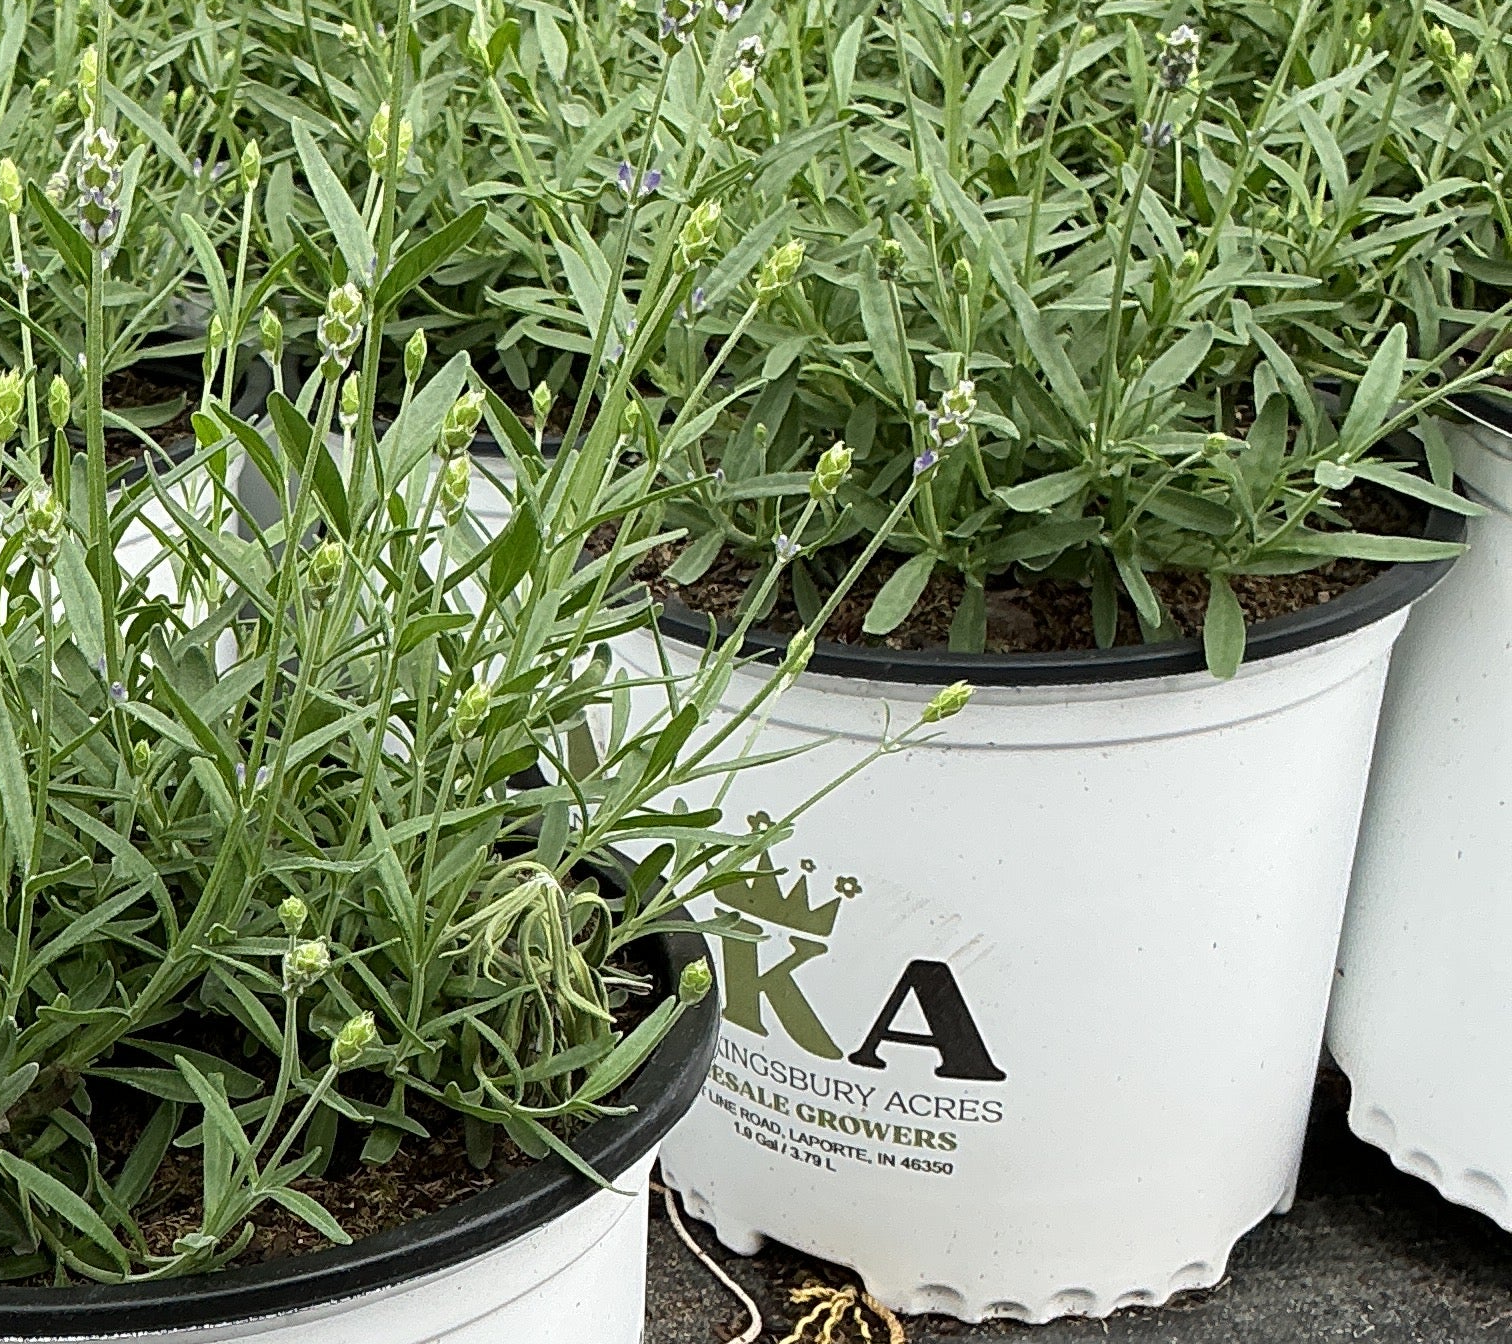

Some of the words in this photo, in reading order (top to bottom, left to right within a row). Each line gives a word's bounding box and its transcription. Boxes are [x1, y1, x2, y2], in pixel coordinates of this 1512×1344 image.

[709, 1064, 790, 1116] ESALE
[795, 1103, 958, 1152] GROWERS
[885, 1090, 1004, 1123] ACRES
[755, 1132, 779, 1152] Gal
[790, 1145, 822, 1168] 3.79
[825, 1157, 837, 1172] L
[877, 1152, 896, 1168] IN
[900, 1156, 954, 1176] 46350
